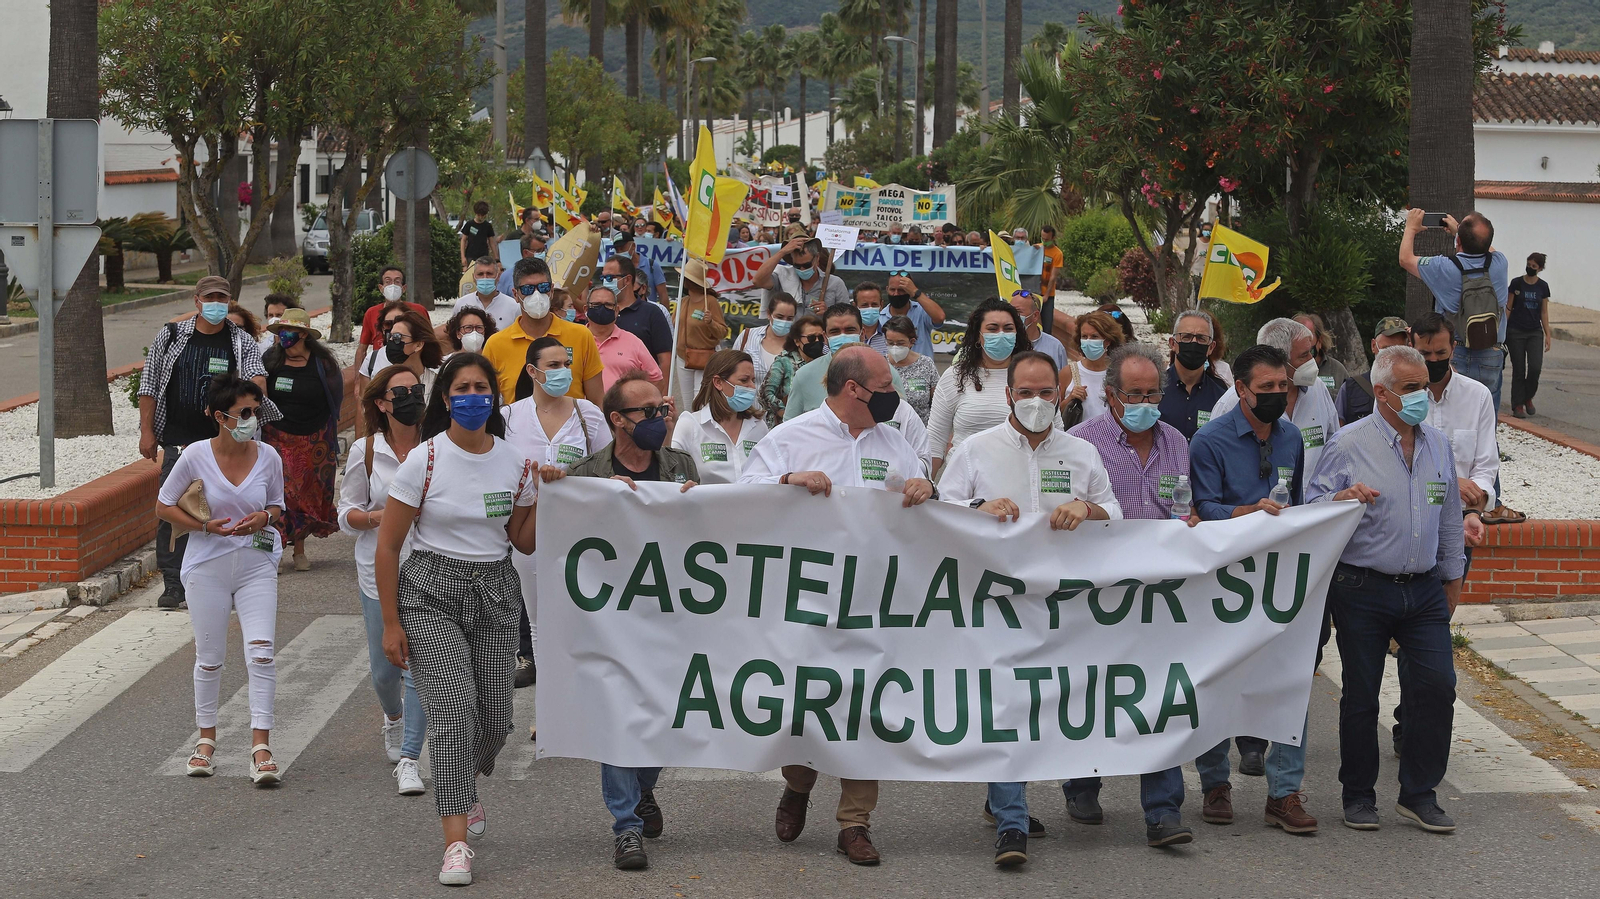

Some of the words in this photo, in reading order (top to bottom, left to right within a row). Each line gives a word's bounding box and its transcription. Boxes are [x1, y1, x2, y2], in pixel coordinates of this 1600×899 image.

[878, 189, 905, 199] MEGA
[840, 198, 854, 206] NO
[878, 198, 904, 207] PARQUES
[917, 202, 931, 210] NO
[739, 200, 756, 214] olar
[876, 214, 903, 222] TAICOS
[872, 221, 888, 229] SOS
[824, 227, 851, 235] Plataforma
[893, 249, 923, 268] DE
[928, 249, 995, 272] JIMEN
[564, 536, 1026, 630] CASTELLAR
[1045, 577, 1188, 630] POR
[1211, 551, 1311, 625] SU
[671, 652, 1200, 746] AGRICULTURA
